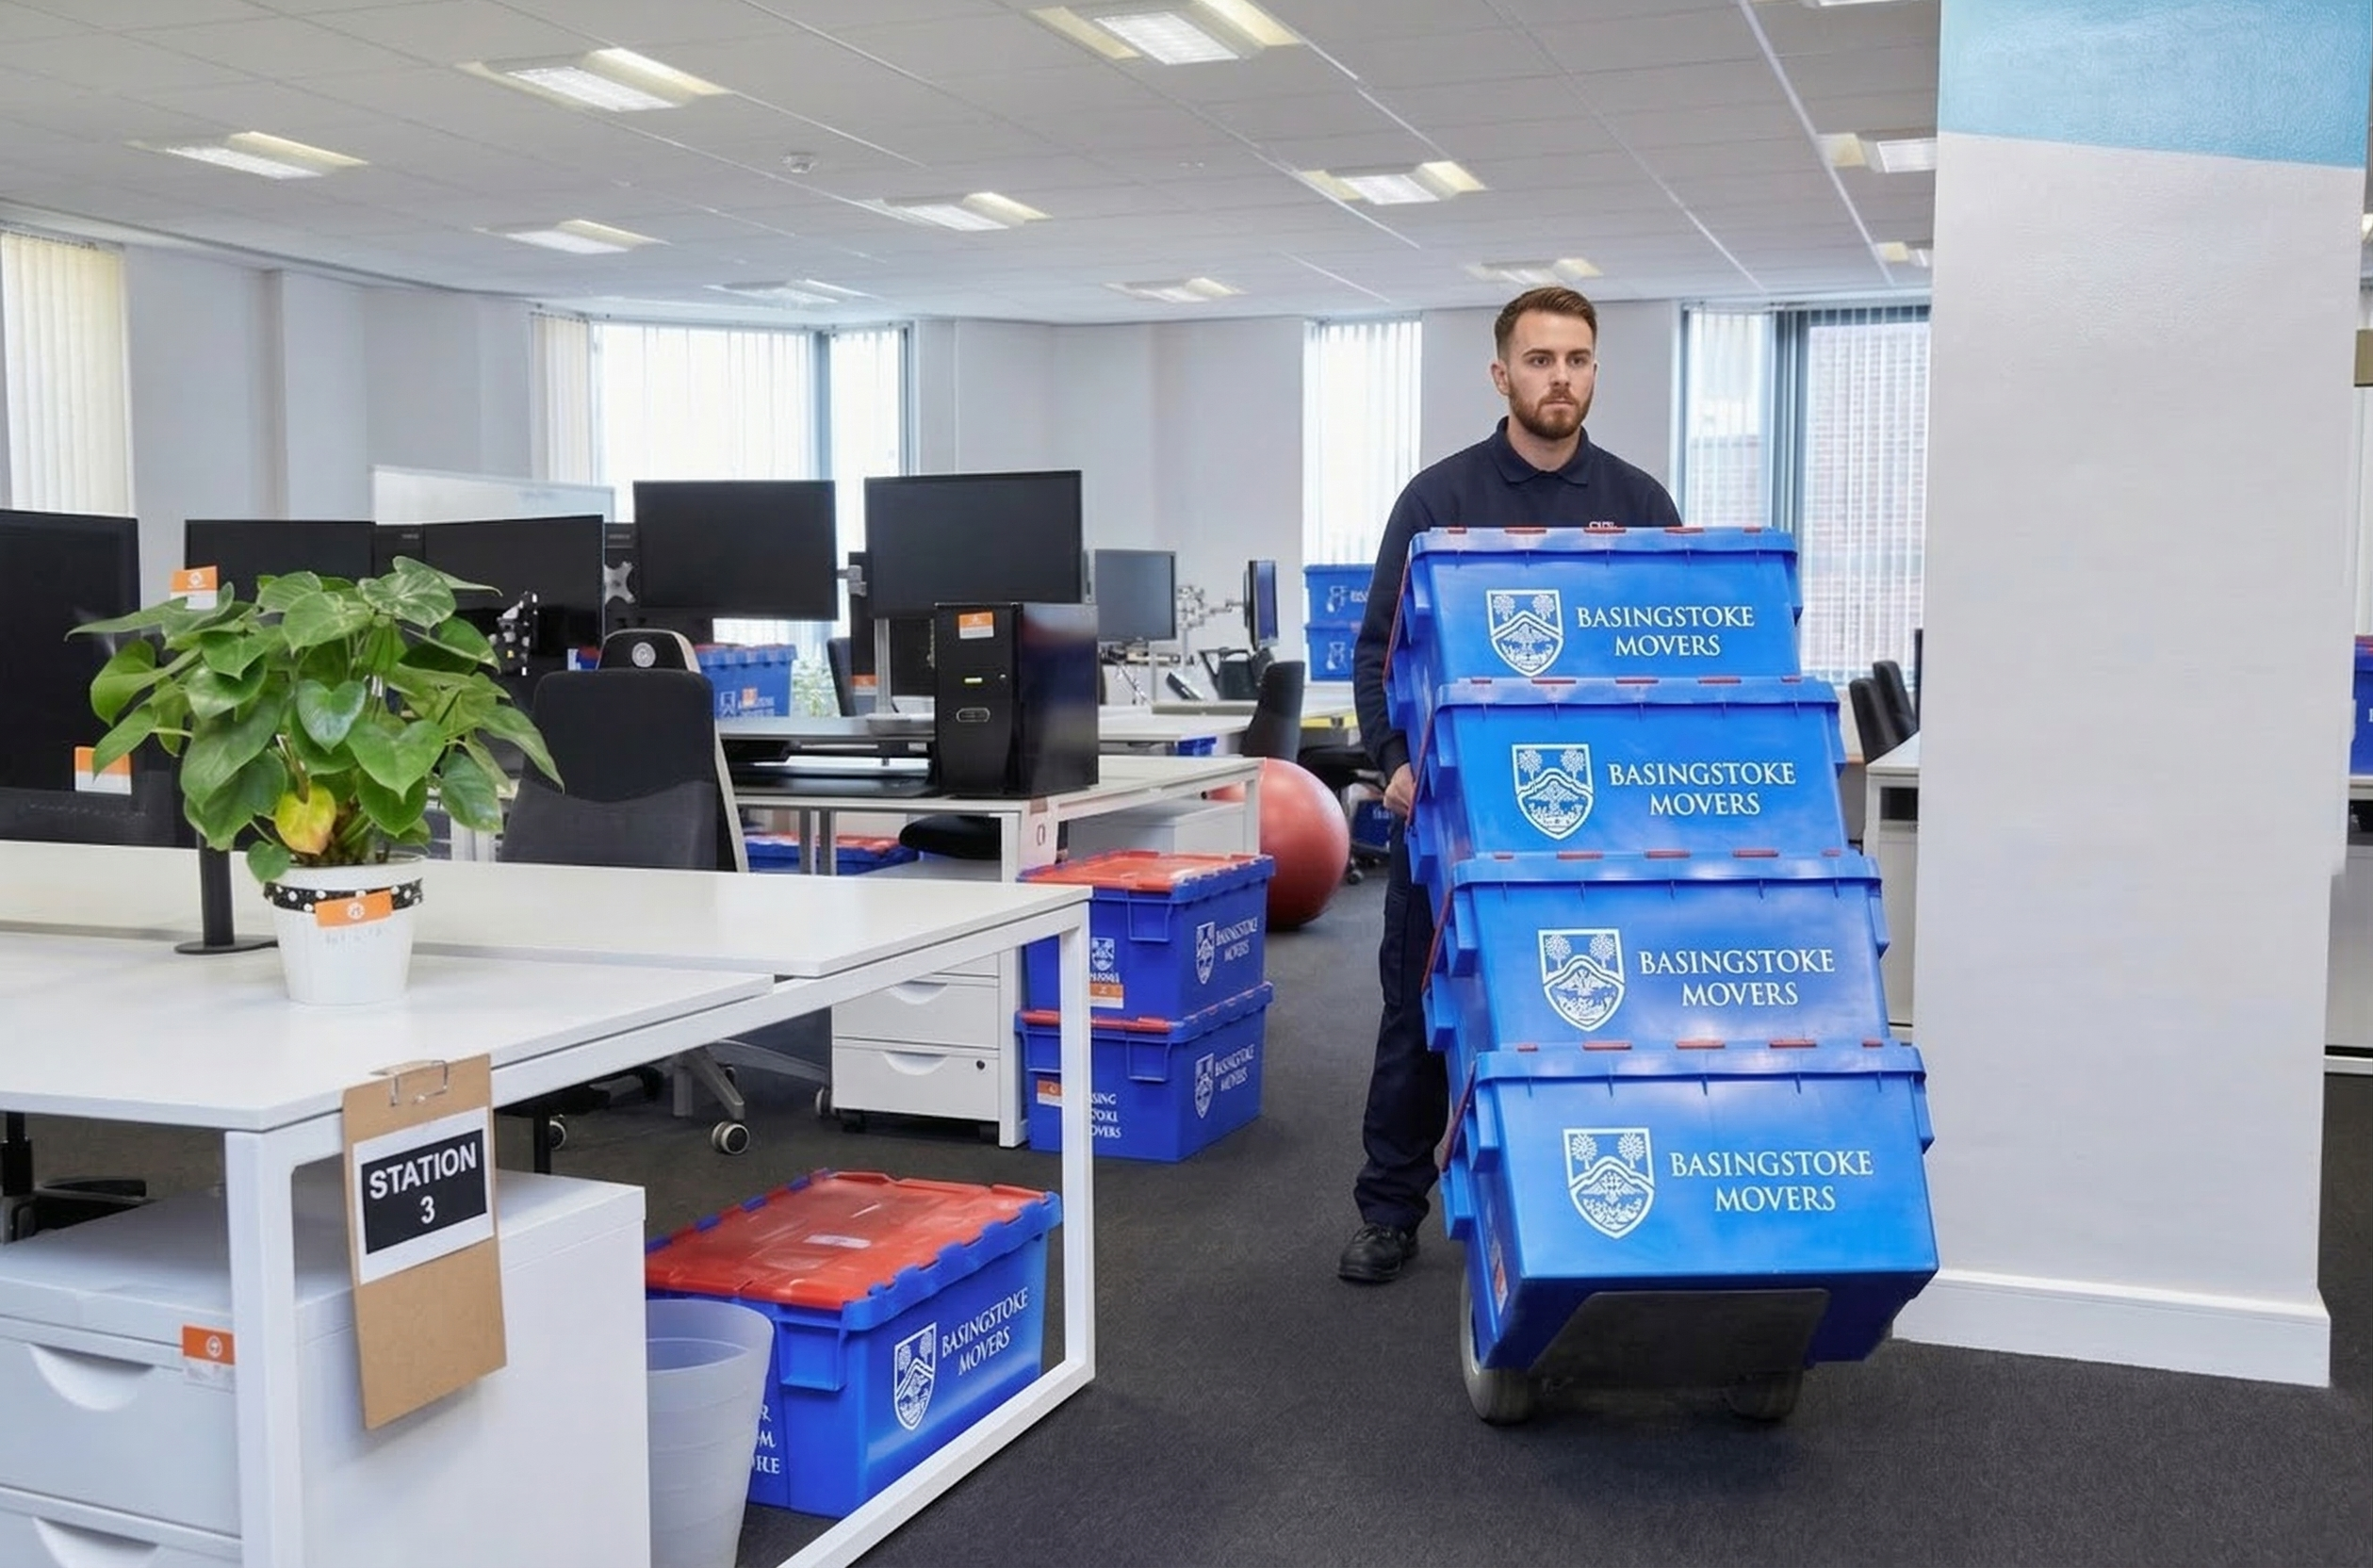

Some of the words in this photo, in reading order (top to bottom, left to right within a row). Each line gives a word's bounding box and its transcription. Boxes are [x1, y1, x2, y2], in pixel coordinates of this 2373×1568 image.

[1576, 605, 1756, 629] BASINGSTOKE
[1613, 634, 1722, 657] MOVERS
[1608, 761, 1797, 787] BASINGSTOKE
[1649, 792, 1761, 816] MOVERS
[1637, 948, 1836, 975] BASINGSTOKE
[1681, 981, 1799, 1007] MOVERS
[368, 1140, 478, 1200] STATION
[1669, 1150, 1874, 1178] BASINGSTOKE
[419, 1195, 436, 1225] 3
[1714, 1184, 1837, 1213] MOVERS
[941, 1287, 1029, 1359] BASINGSTOKE
[957, 1325, 1011, 1377] MOVERS
